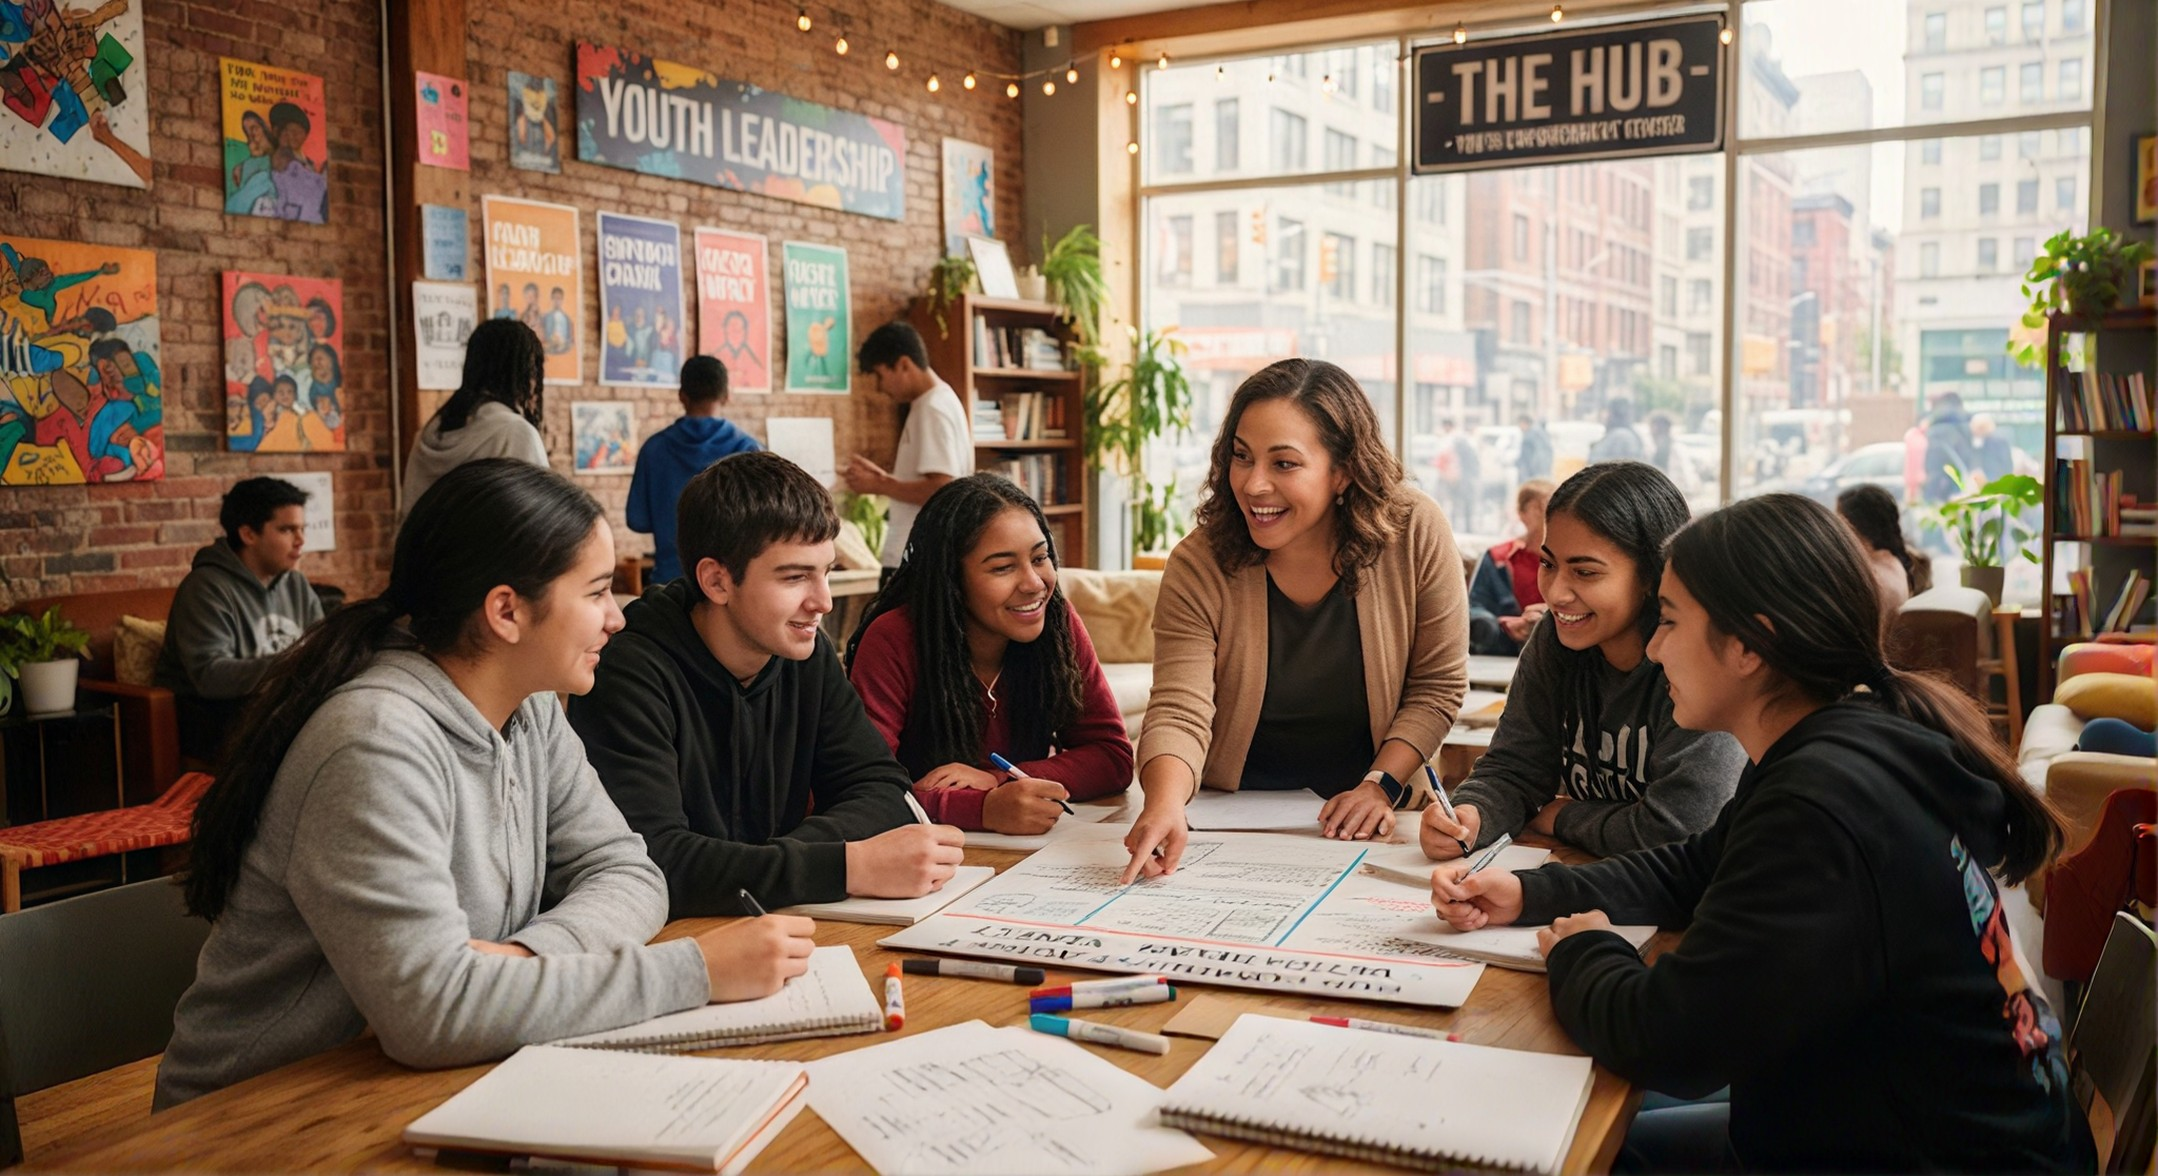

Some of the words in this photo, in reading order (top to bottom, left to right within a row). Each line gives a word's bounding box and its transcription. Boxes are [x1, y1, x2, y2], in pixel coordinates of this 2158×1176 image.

[1452, 54, 1553, 125] THE
[1570, 39, 1684, 115] HUB
[599, 76, 714, 158] YOUTH
[722, 108, 894, 193] LEADERSHIP
